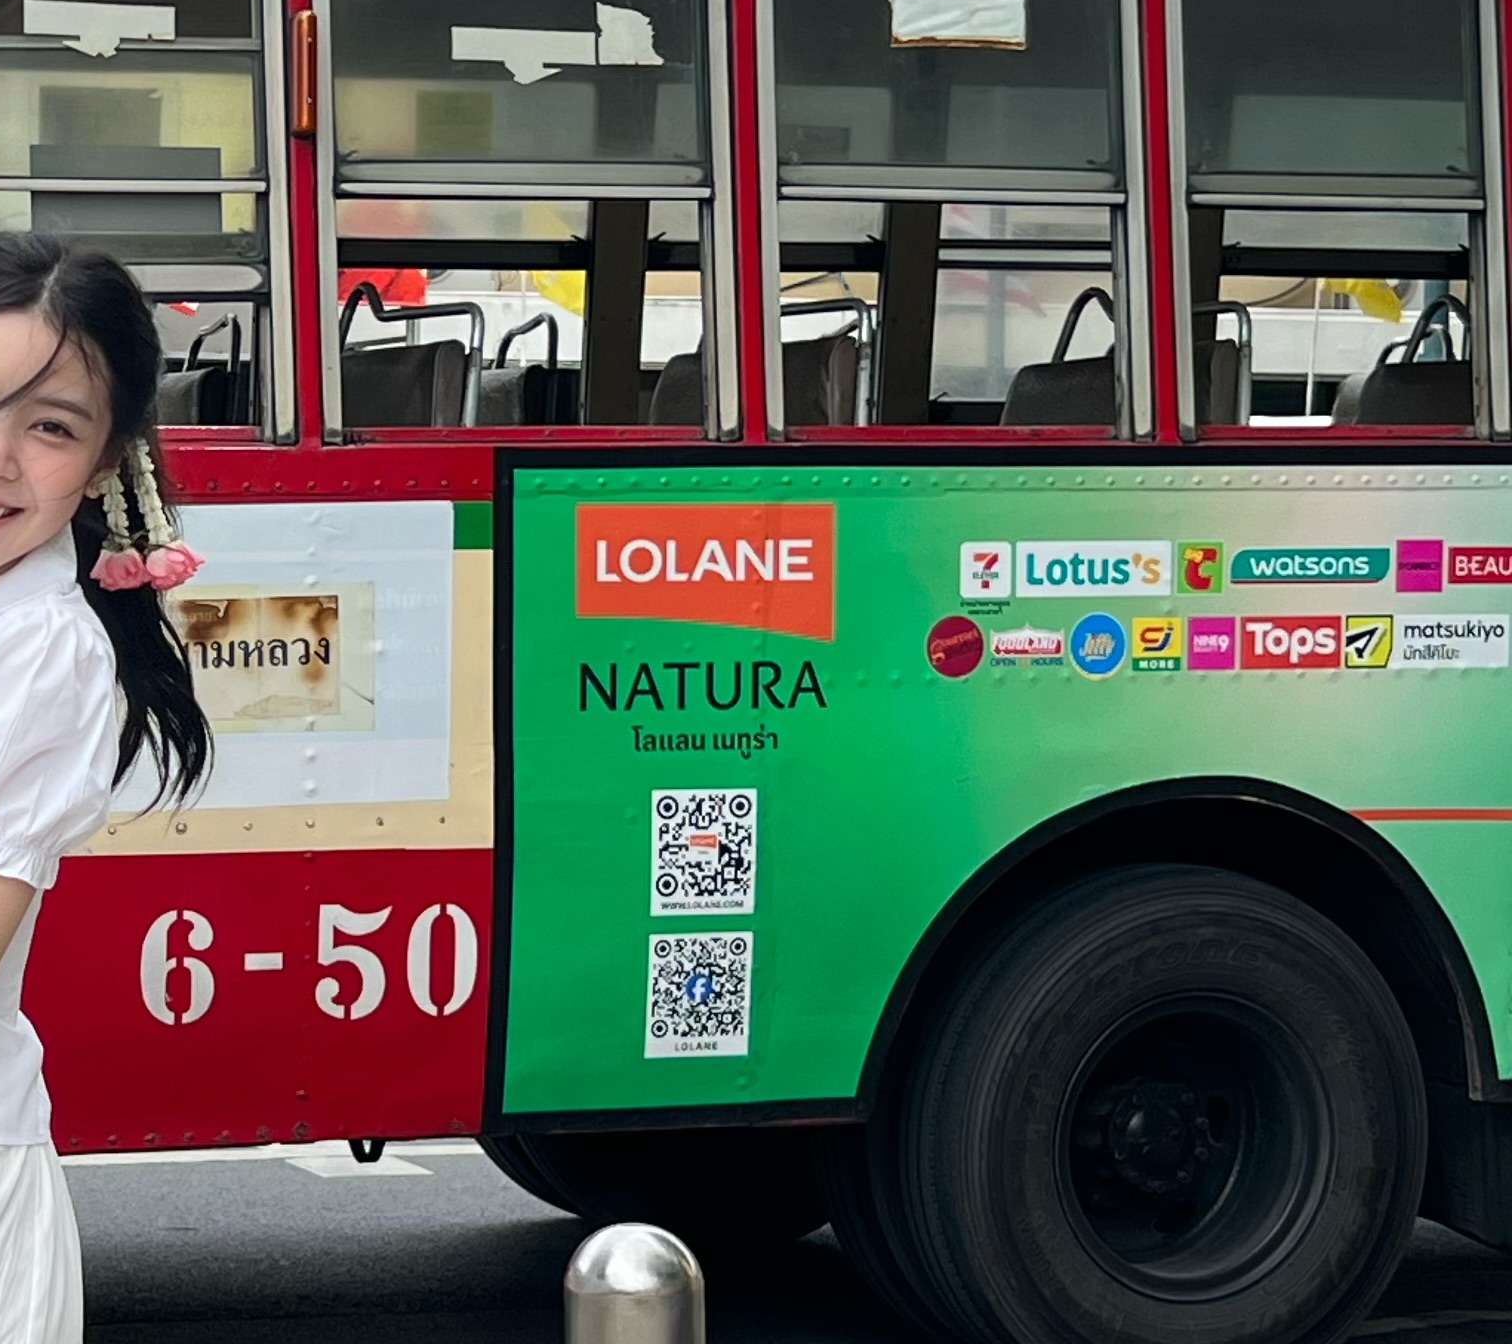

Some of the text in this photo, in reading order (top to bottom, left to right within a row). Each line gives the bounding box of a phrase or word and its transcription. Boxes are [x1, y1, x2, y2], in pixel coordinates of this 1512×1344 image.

[596, 539, 814, 583] LOLANE
[1026, 552, 1161, 585] Lotus's
[1249, 555, 1370, 576] watsons
[1455, 555, 1512, 576] BEAU
[1246, 621, 1337, 664] Tops
[1403, 620, 1504, 643] matsukiyo
[1138, 659, 1175, 669] MORE
[579, 660, 827, 711] NATURA
[631, 723, 779, 759] โลแลน เนทูร่า
[674, 1041, 719, 1052] LOLANE
